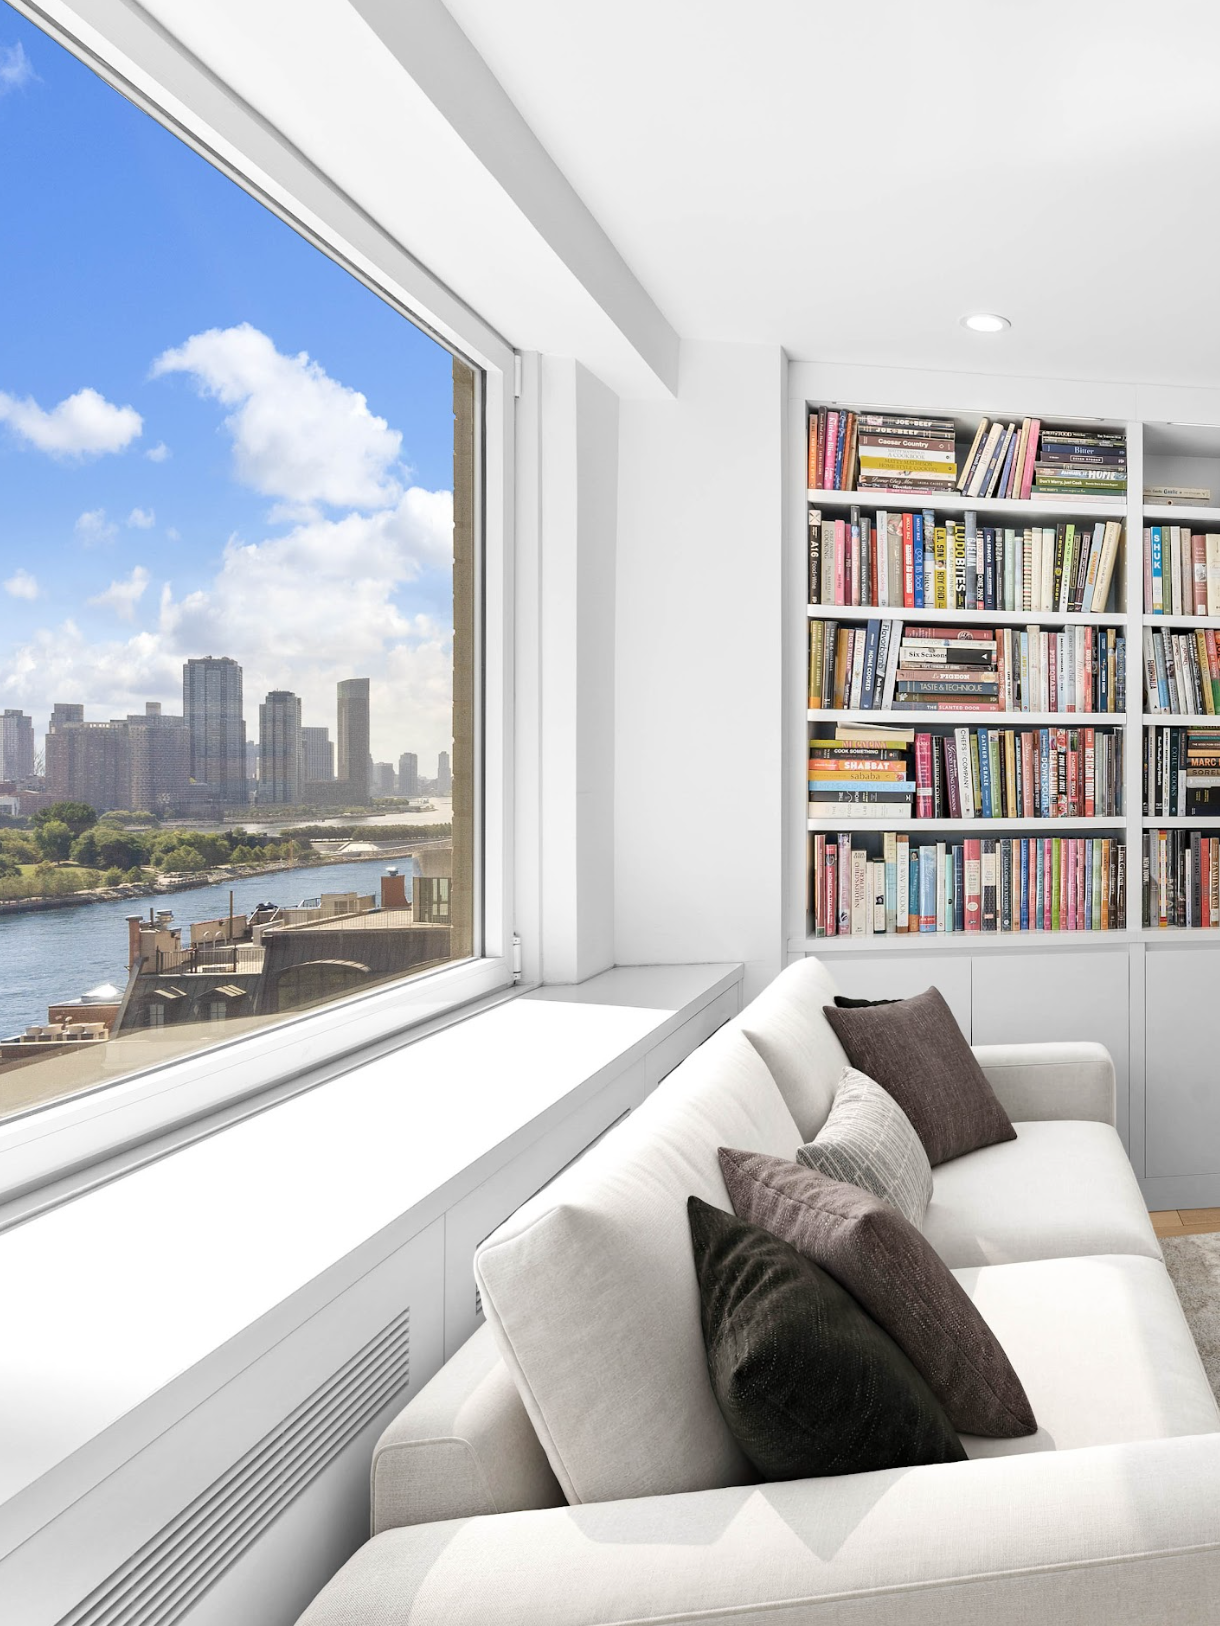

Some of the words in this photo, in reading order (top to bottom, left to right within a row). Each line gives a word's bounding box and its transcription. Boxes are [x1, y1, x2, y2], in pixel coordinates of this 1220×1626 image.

[878, 438, 901, 446] Caesar
[903, 440, 929, 449] Country
[1074, 446, 1094, 455] Bitter
[936, 530, 945, 543] L.A.
[936, 545, 945, 558] SON
[955, 526, 965, 592] LUDOBITES
[936, 571, 945, 584] ROY
[865, 667, 873, 691] COOKED
[946, 684, 983, 692] TECHNIQUE
[844, 761, 890, 770] SHABBAT
[1049, 749, 1058, 769] REAL
[1085, 748, 1095, 778] MEXICAN
[1191, 758, 1217, 767] MARC
[850, 772, 881, 780] sababa
[1085, 778, 1095, 800] TODAY
[1167, 878, 1175, 917] MEAT
[899, 895, 907, 915] COOK
